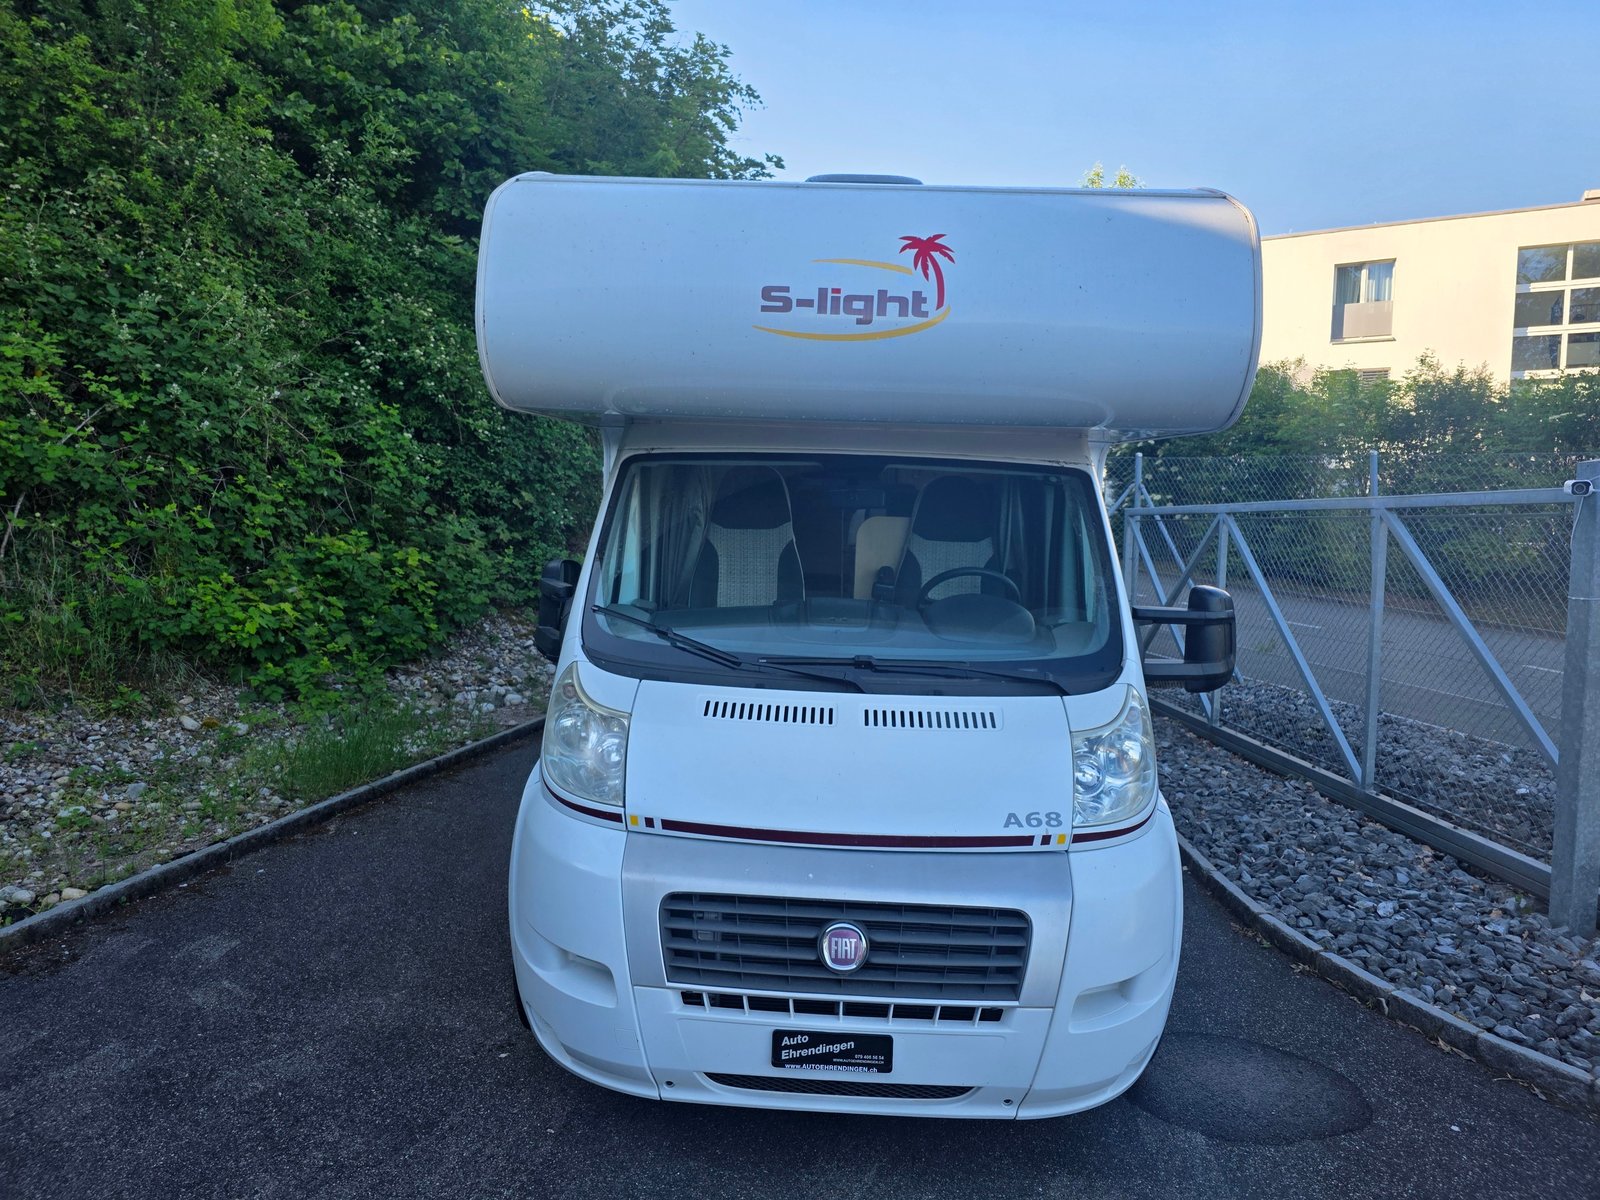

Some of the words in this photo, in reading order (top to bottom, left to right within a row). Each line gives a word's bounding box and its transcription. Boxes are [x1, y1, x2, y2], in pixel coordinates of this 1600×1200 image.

[760, 285, 929, 325] S-light
[1003, 811, 1063, 828] A68
[831, 937, 857, 959] FIAT
[781, 1034, 809, 1046] Auto
[781, 1041, 855, 1059] Ehrendingen
